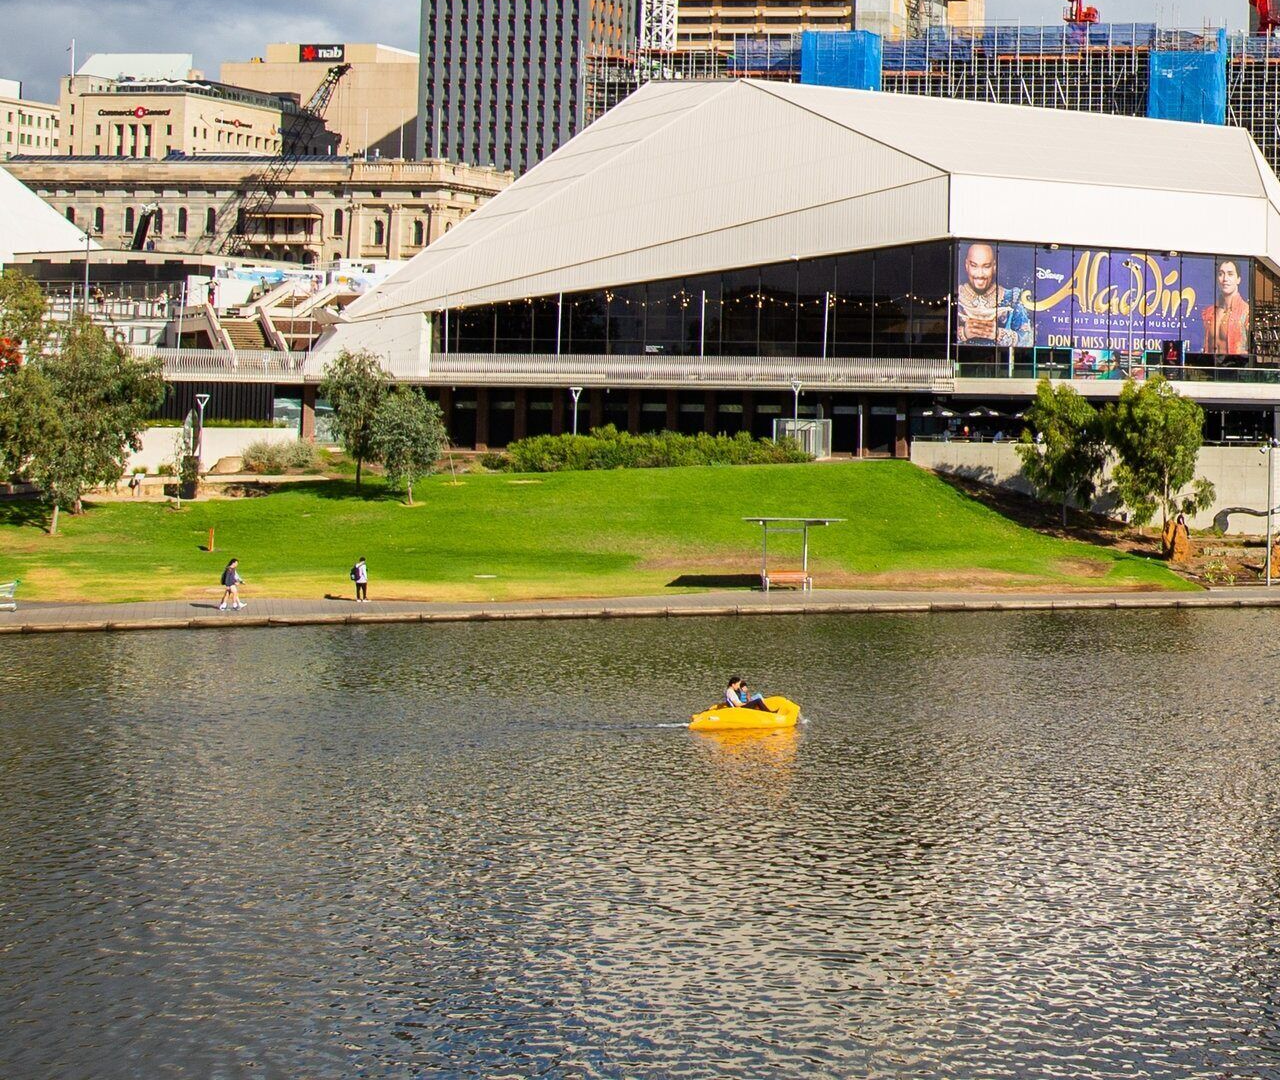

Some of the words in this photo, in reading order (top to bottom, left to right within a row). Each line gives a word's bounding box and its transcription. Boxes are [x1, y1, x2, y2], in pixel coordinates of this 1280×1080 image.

[318, 46, 343, 59] nab
[97, 108, 135, 117] Commercia
[1036, 267, 1065, 284] Disney
[1020, 250, 1197, 318] Aladdin
[1093, 318, 1145, 327] BROADWAY
[1148, 320, 1188, 329] MUSICAL
[1048, 334, 1079, 348] DONT
[1081, 335, 1105, 349] MISS
[1133, 338, 1162, 351] BOOK
